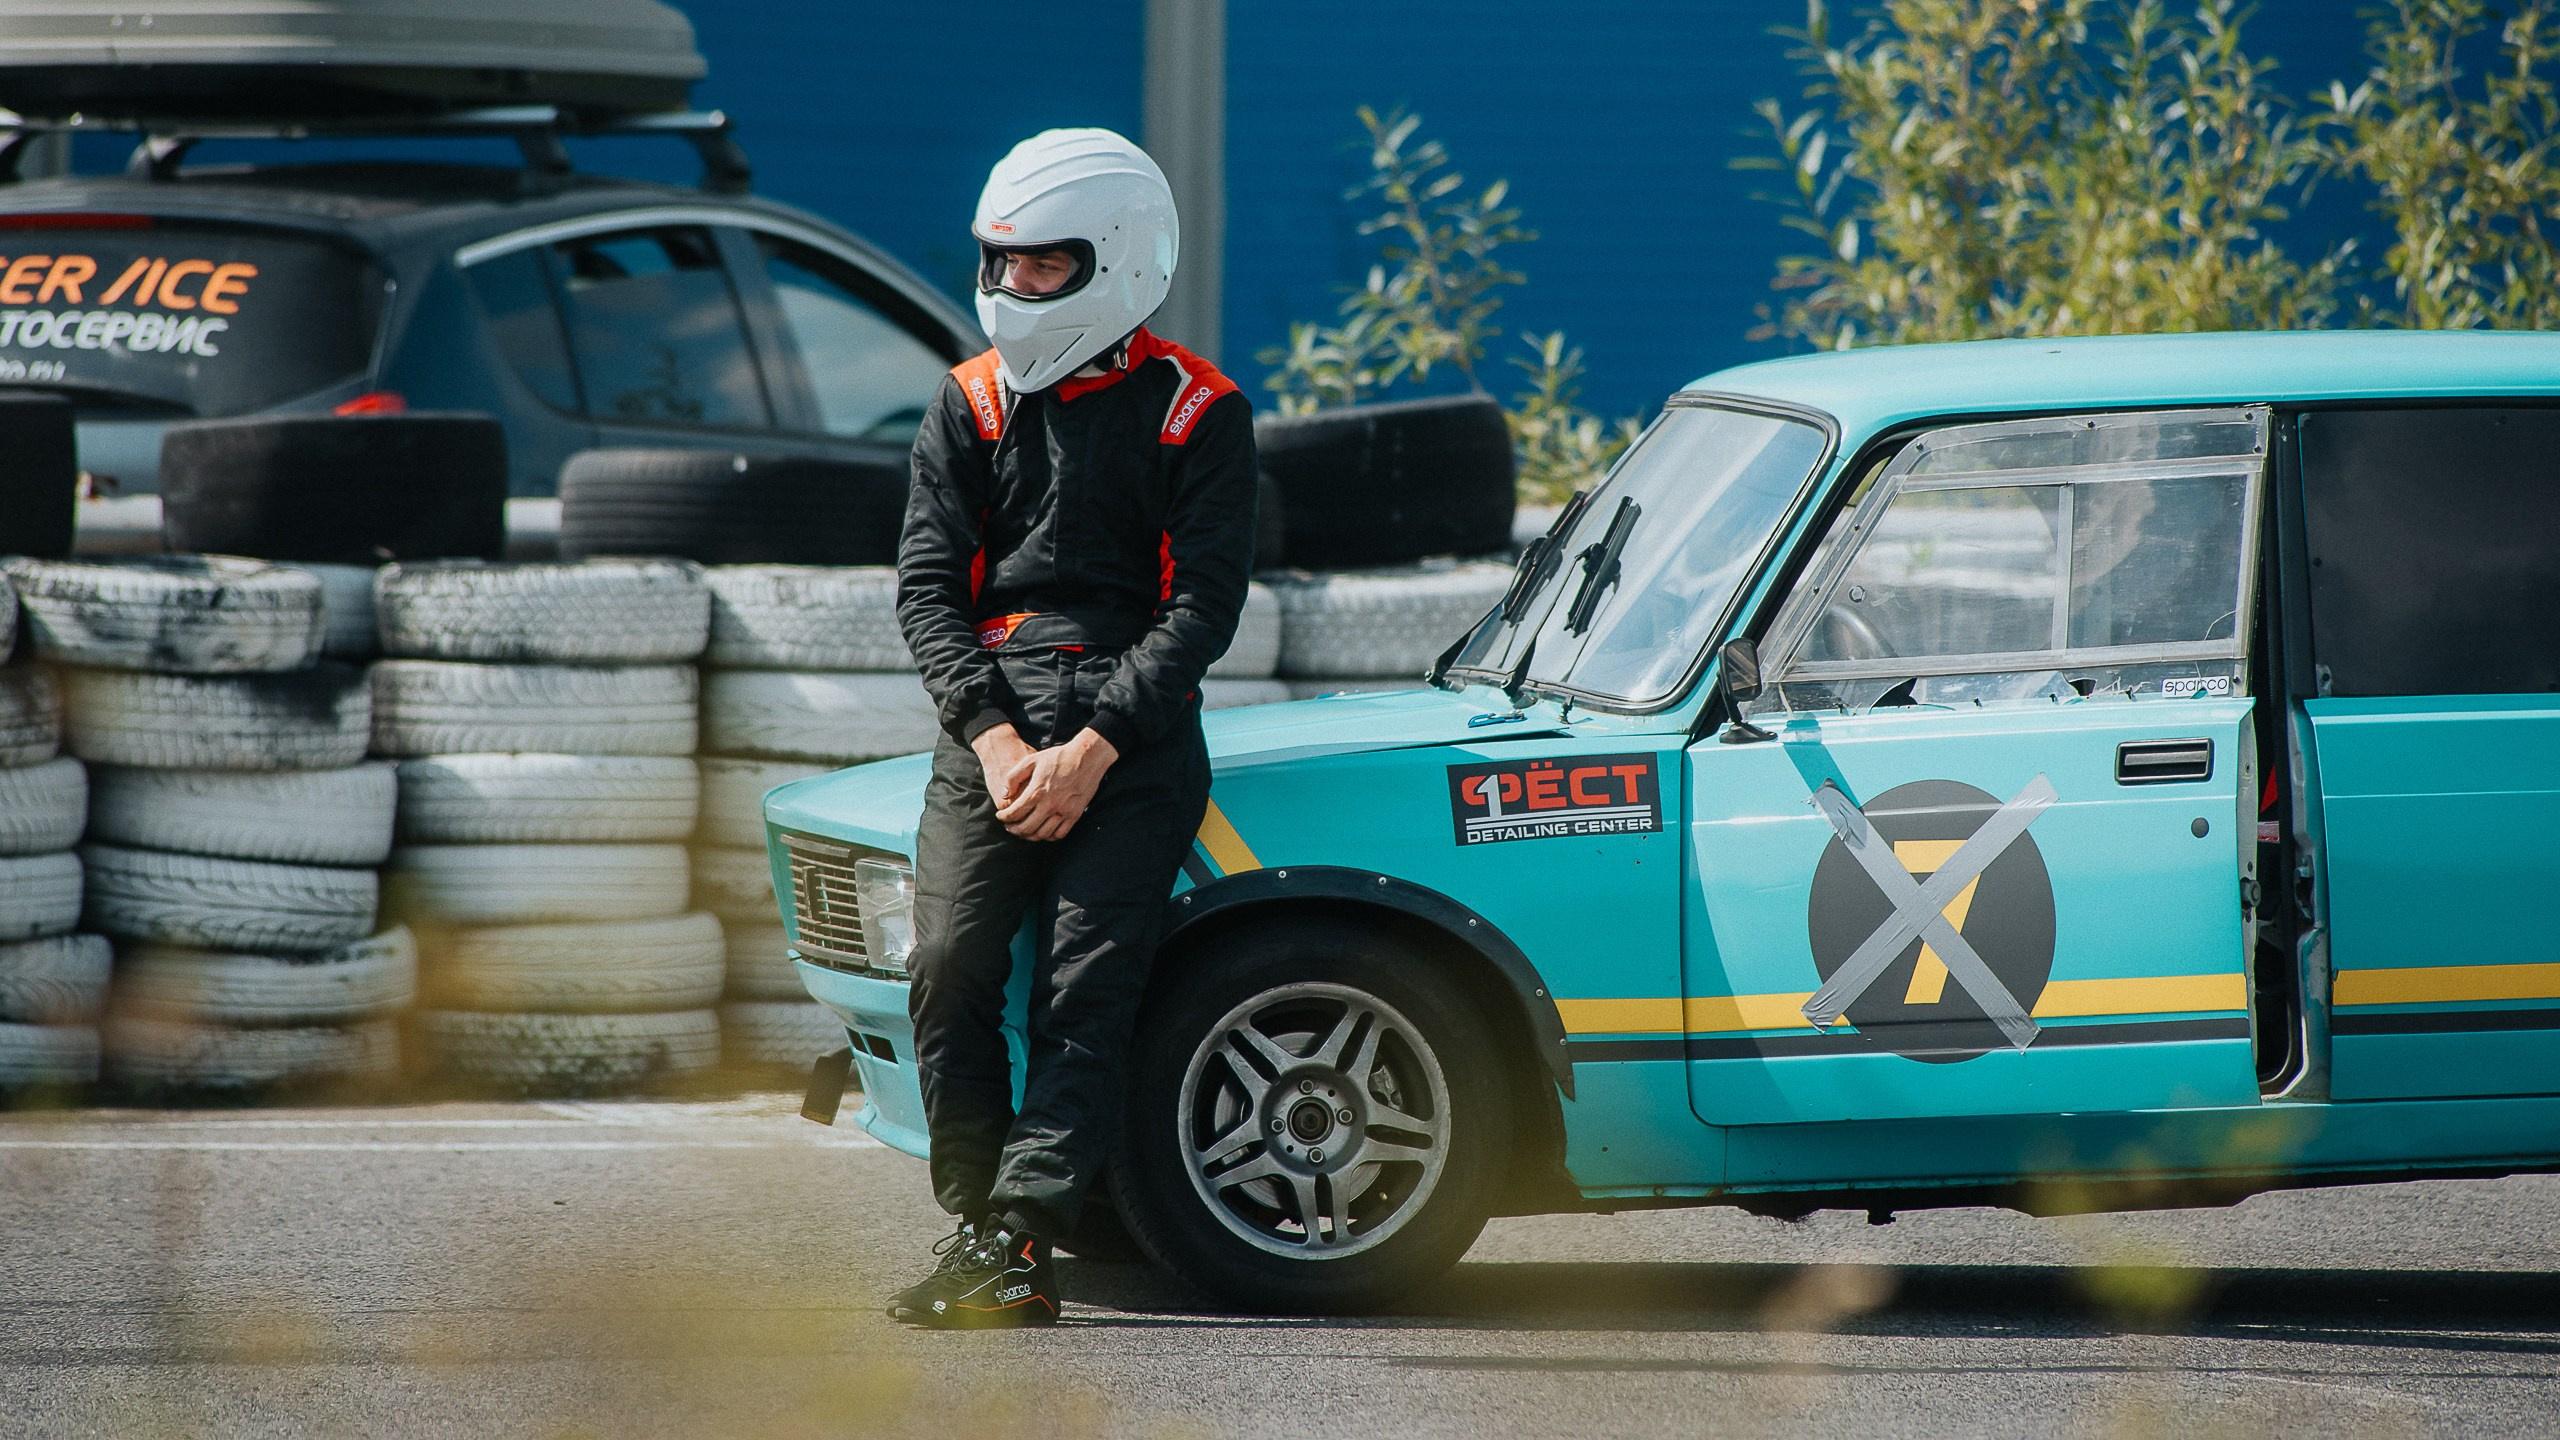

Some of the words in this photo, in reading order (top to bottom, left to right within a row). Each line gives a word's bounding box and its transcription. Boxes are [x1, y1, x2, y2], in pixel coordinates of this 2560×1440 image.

[968, 377, 998, 432] sparco
[1169, 385, 1213, 436] sparco
[2164, 677, 2228, 696] sparco
[1467, 822, 1569, 844] DETAILING
[1574, 817, 1653, 834] CENTER
[1893, 839, 1984, 1004] 7
[996, 1283, 1032, 1304] sparco
